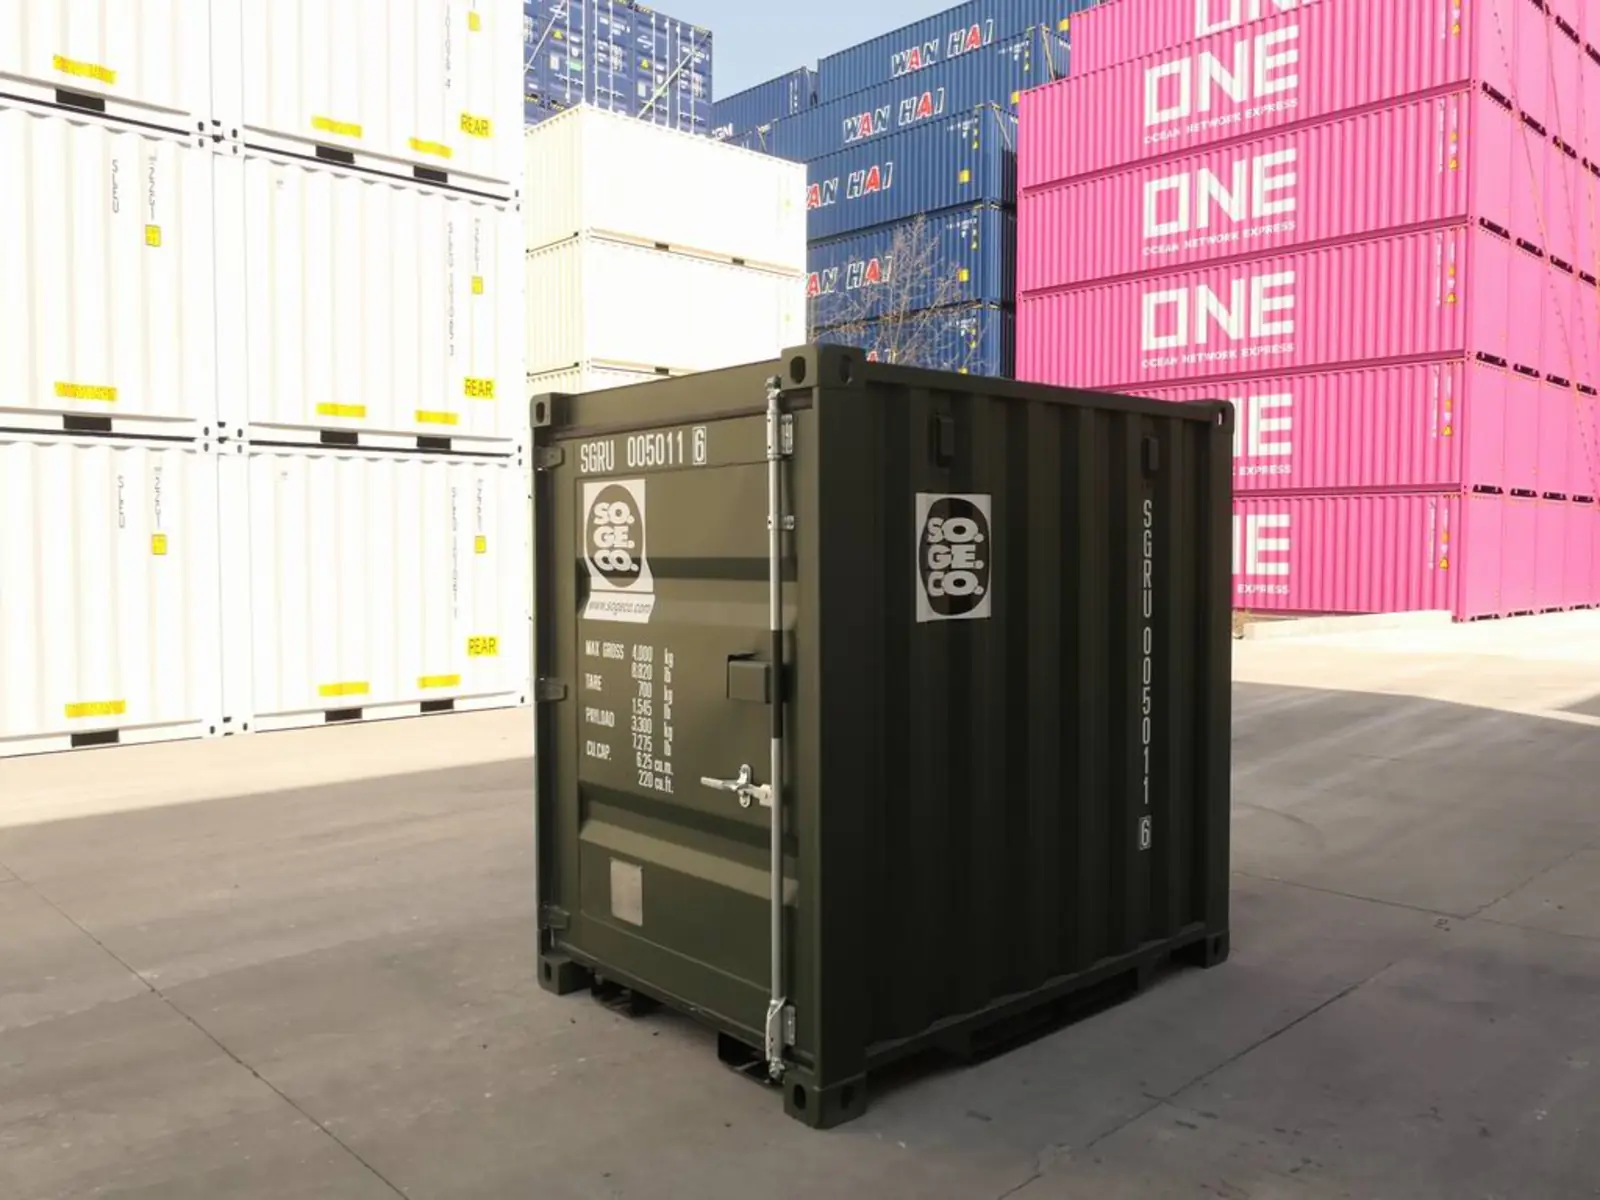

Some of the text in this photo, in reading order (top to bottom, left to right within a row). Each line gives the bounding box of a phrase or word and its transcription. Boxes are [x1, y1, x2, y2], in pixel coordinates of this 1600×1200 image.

[891, 38, 940, 77] WAN
[947, 18, 994, 59] HAI
[1144, 25, 1299, 126] ONE
[461, 113, 489, 136] REAR
[843, 87, 945, 143] WAN HAI
[1187, 111, 1242, 133] NETWORK
[1245, 98, 1298, 119] EXPRESS
[846, 161, 893, 199] HAI
[1143, 148, 1296, 239] ONE
[1183, 230, 1239, 249] NETWORK
[1242, 221, 1295, 239] EXPRESS
[846, 255, 893, 290] HAI
[1142, 271, 1295, 350] ONE
[1182, 348, 1238, 365] NETWORK
[1241, 343, 1294, 359] EXPRESS
[464, 379, 493, 397] REAR
[580, 427, 706, 473] SGRU 005011 6
[1239, 464, 1291, 476] EXPRESS
[593, 501, 635, 525] SO.
[593, 526, 635, 549] GE.
[927, 516, 984, 544] SO.
[594, 549, 639, 573] CO.
[927, 544, 984, 570] GE.
[928, 570, 984, 597] CO.
[1237, 583, 1289, 595] EXPRESS
[588, 600, 652, 616] www.sogeco.com
[468, 637, 496, 655] REAR
[585, 640, 600, 656] MAX
[602, 642, 624, 660] GROSS
[664, 648, 674, 668] kg
[1139, 499, 1153, 850] SGRU 005011 6
[585, 673, 673, 705] TARE 700 kg
[585, 707, 615, 728] PAYLOAD
[664, 721, 673, 742] kg
[638, 769, 653, 788] 220
